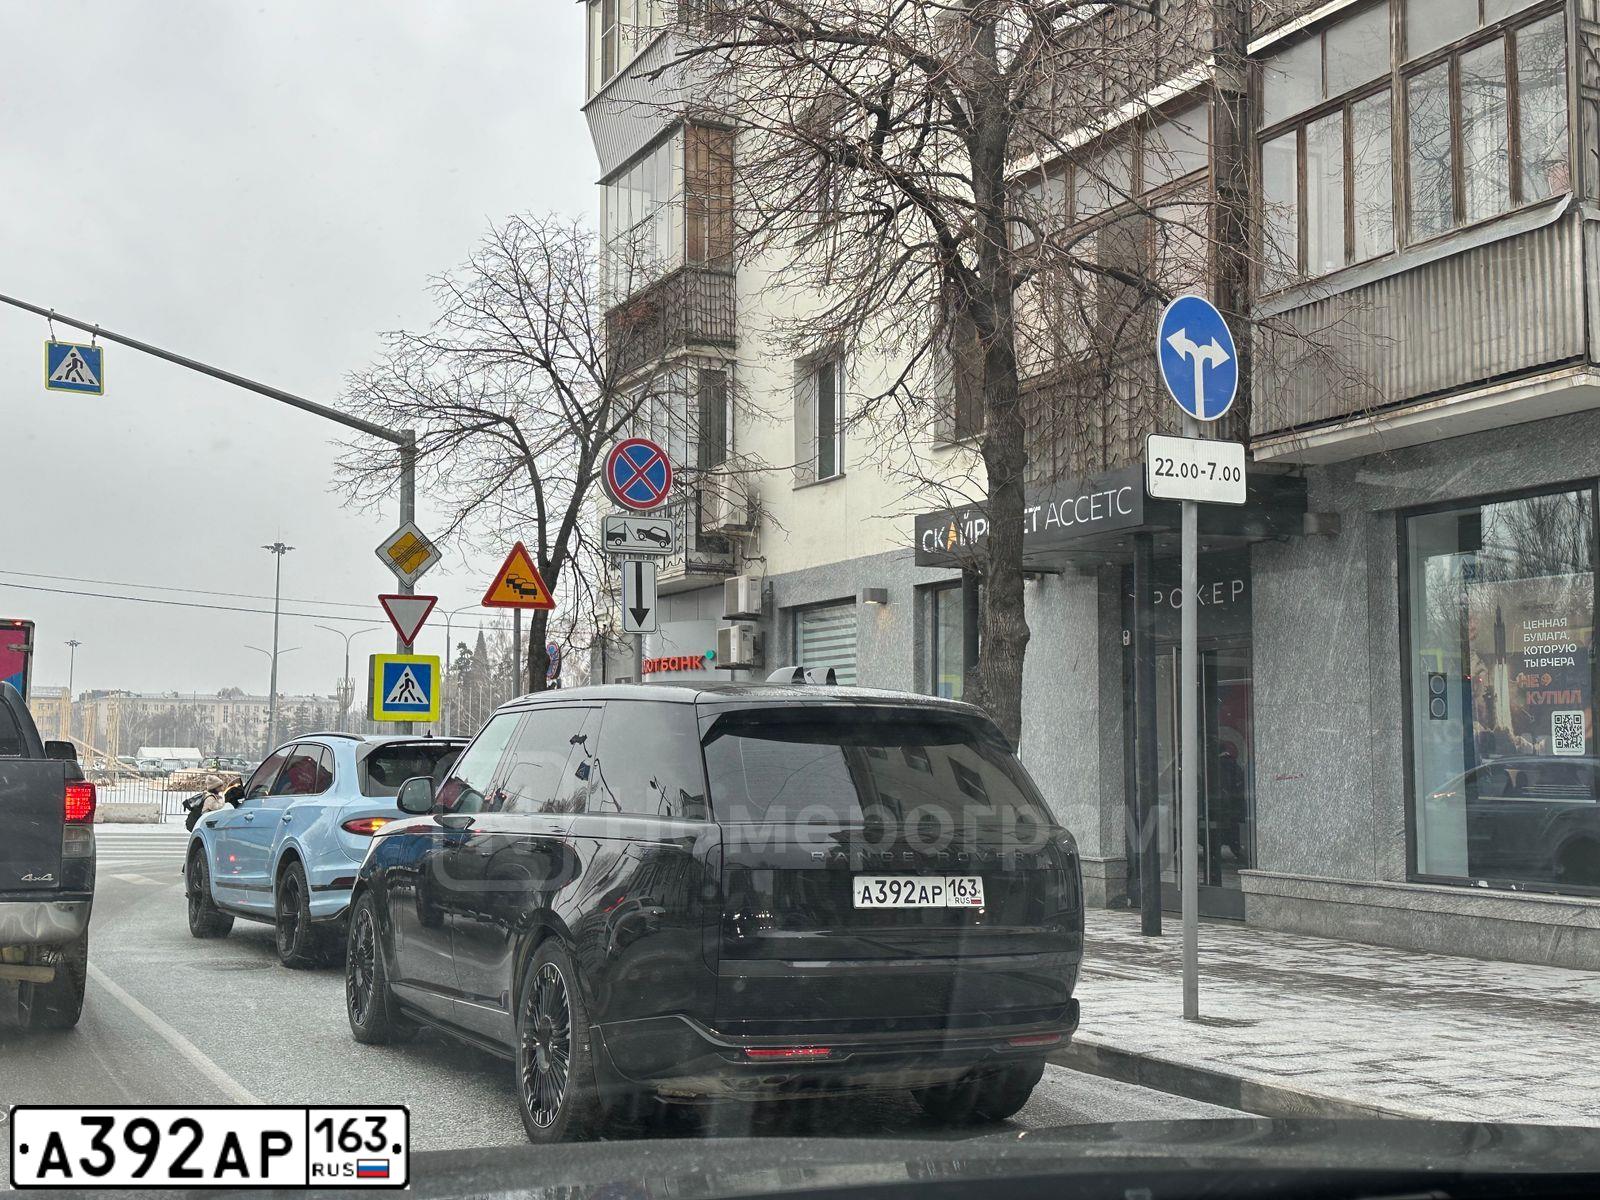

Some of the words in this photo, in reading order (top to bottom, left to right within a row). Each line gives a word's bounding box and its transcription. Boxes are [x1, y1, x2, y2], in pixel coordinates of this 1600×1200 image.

[1155, 458, 1241, 482] 22.00-7.00
[922, 505, 1041, 553] СКАЙРТ
[1045, 486, 1132, 531] АССЕТС
[1154, 579, 1244, 609] РОКЕР
[1523, 617, 1567, 630] ЦЕННАЯ
[1524, 643, 1577, 655] КОТОРУЮ
[1524, 658, 1539, 668] ТЫ
[1540, 657, 1575, 667] ВЧЕРА
[1526, 688, 1582, 705] КУПИЛ
[861, 880, 942, 904] А392АР
[948, 879, 977, 897] 163
[955, 896, 971, 904] RUS
